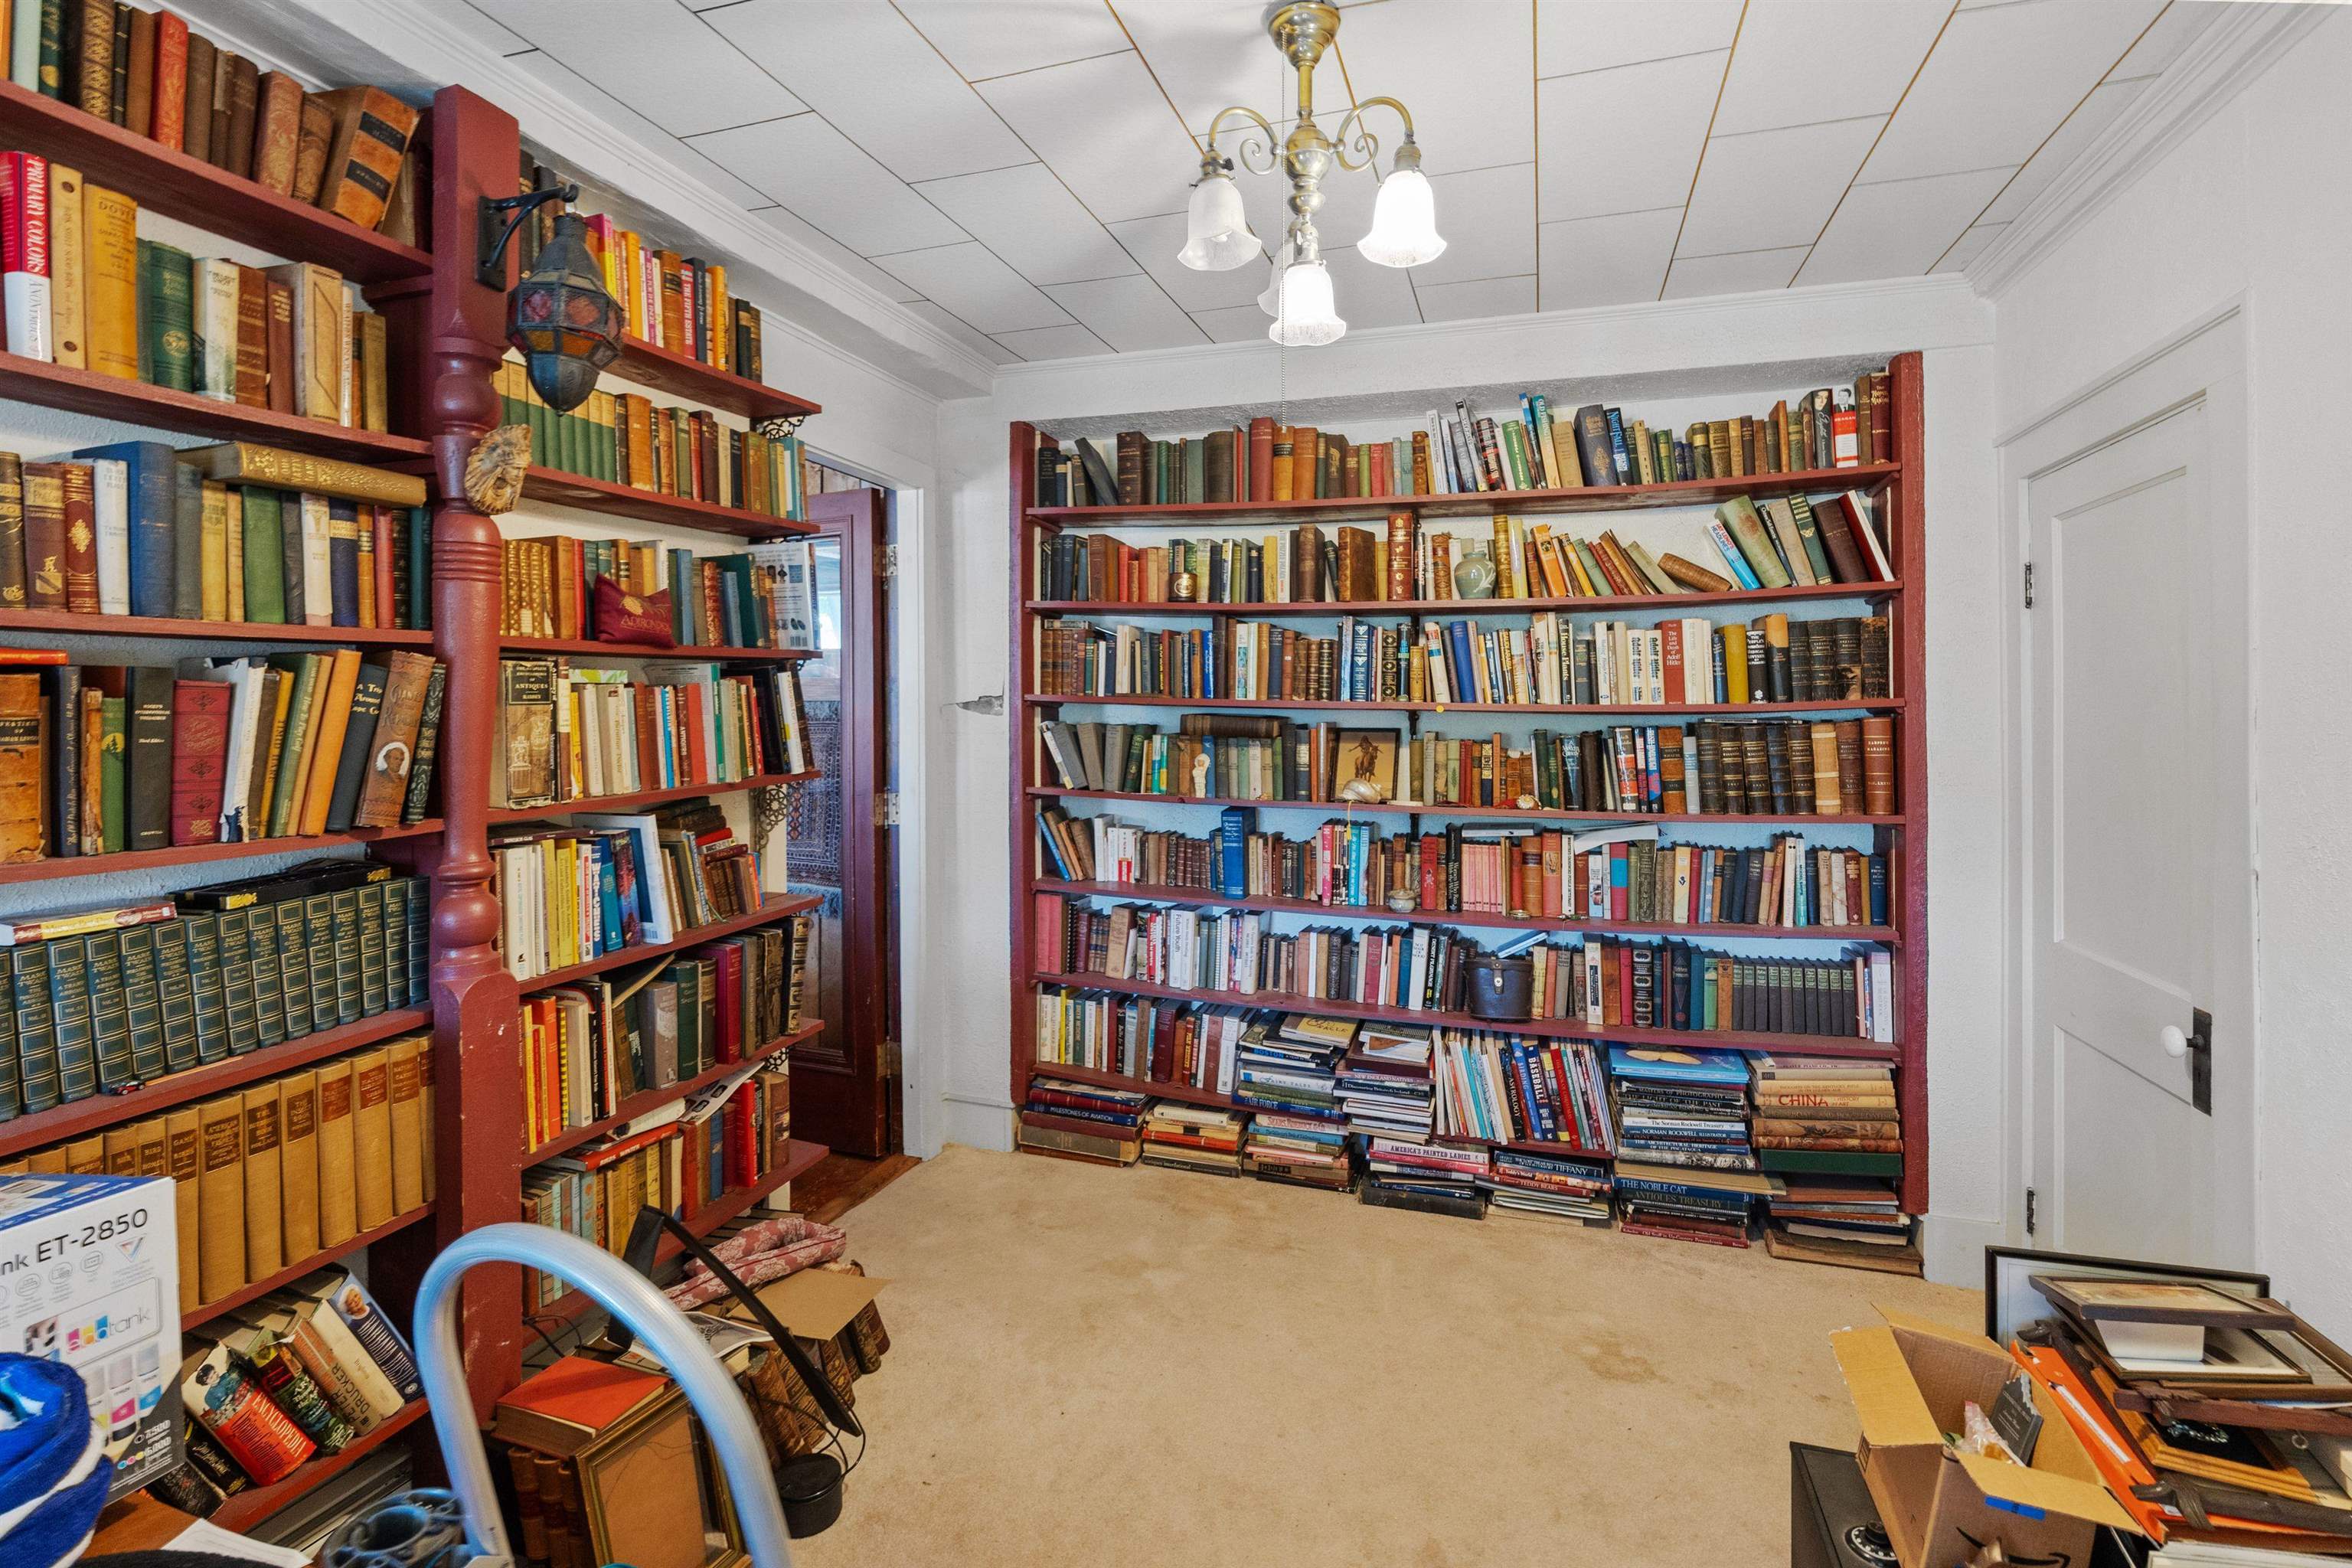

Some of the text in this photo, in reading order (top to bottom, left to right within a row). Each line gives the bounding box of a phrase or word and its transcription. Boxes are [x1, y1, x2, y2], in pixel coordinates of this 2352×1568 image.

[27, 159, 44, 274] PRIMARY COLORS
[1253, 1048, 1284, 1059] BOSTON
[1517, 1062, 1528, 1090] BIRDING
[1528, 1057, 1544, 1103] BASEBALL
[1348, 1083, 1373, 1091] Discovering
[1677, 1090, 1723, 1099] PHOTOGRAPHY
[1259, 1099, 1278, 1109] FORCE
[1508, 1076, 1521, 1118] ASTROLOGY
[1779, 1095, 1829, 1107] CHINA
[1050, 1107, 1080, 1117] MILESTONES
[1090, 1112, 1113, 1122] AVIATION
[1390, 1144, 1472, 1161] AMERICA'S PAINTED LADIES
[1554, 1163, 1588, 1176] TIFFANY
[1521, 1181, 1559, 1191] TEDDY BEARS
[1621, 1180, 1687, 1194] THE NOBLE CAT
[1635, 1191, 1723, 1208] ANTIQUES TREASURY
[36, 1208, 148, 1263] ET-2850
[331, 1363, 371, 1413] DRUCKER
[331, 1390, 358, 1423] PETER
[252, 1391, 308, 1459] ENCYCLOPEDIA
